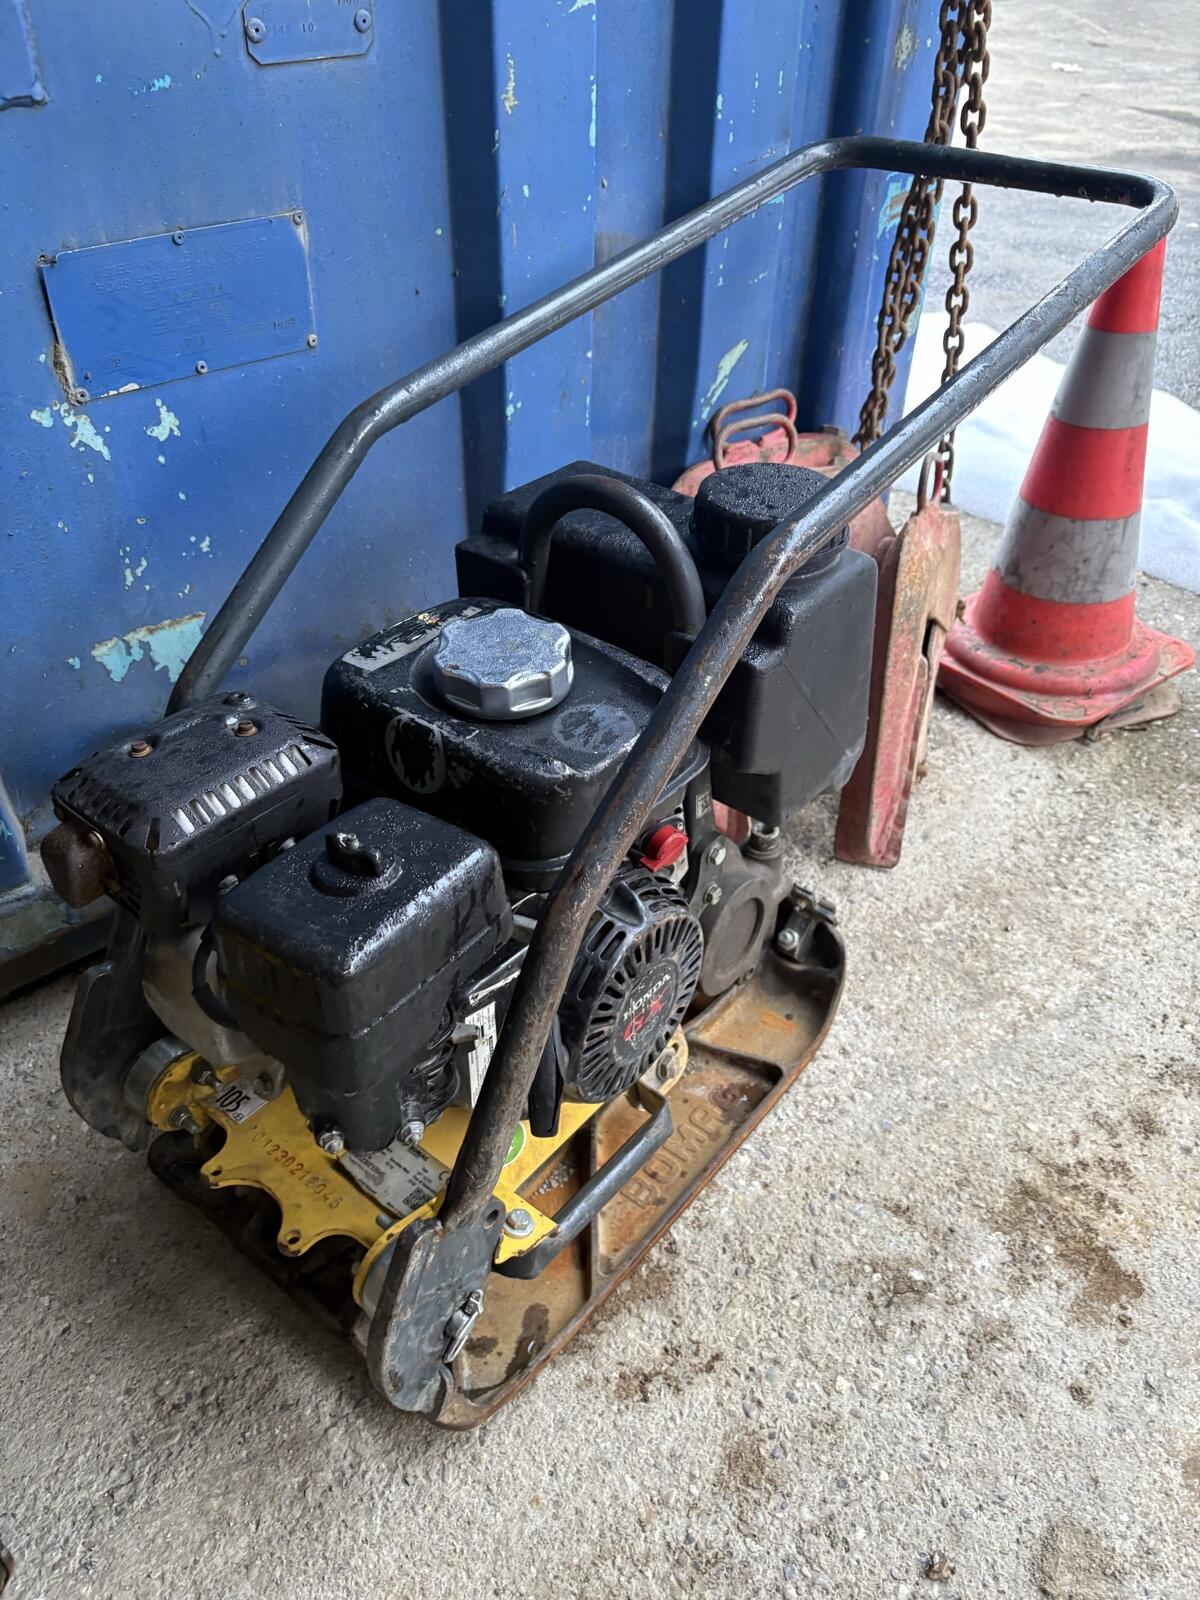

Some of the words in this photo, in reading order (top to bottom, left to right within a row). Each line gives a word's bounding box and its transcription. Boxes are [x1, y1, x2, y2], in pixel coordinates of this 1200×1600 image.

[623, 974, 671, 1021] HONDA
[215, 1085, 250, 1112] 105
[619, 1084, 738, 1209] BOMA
